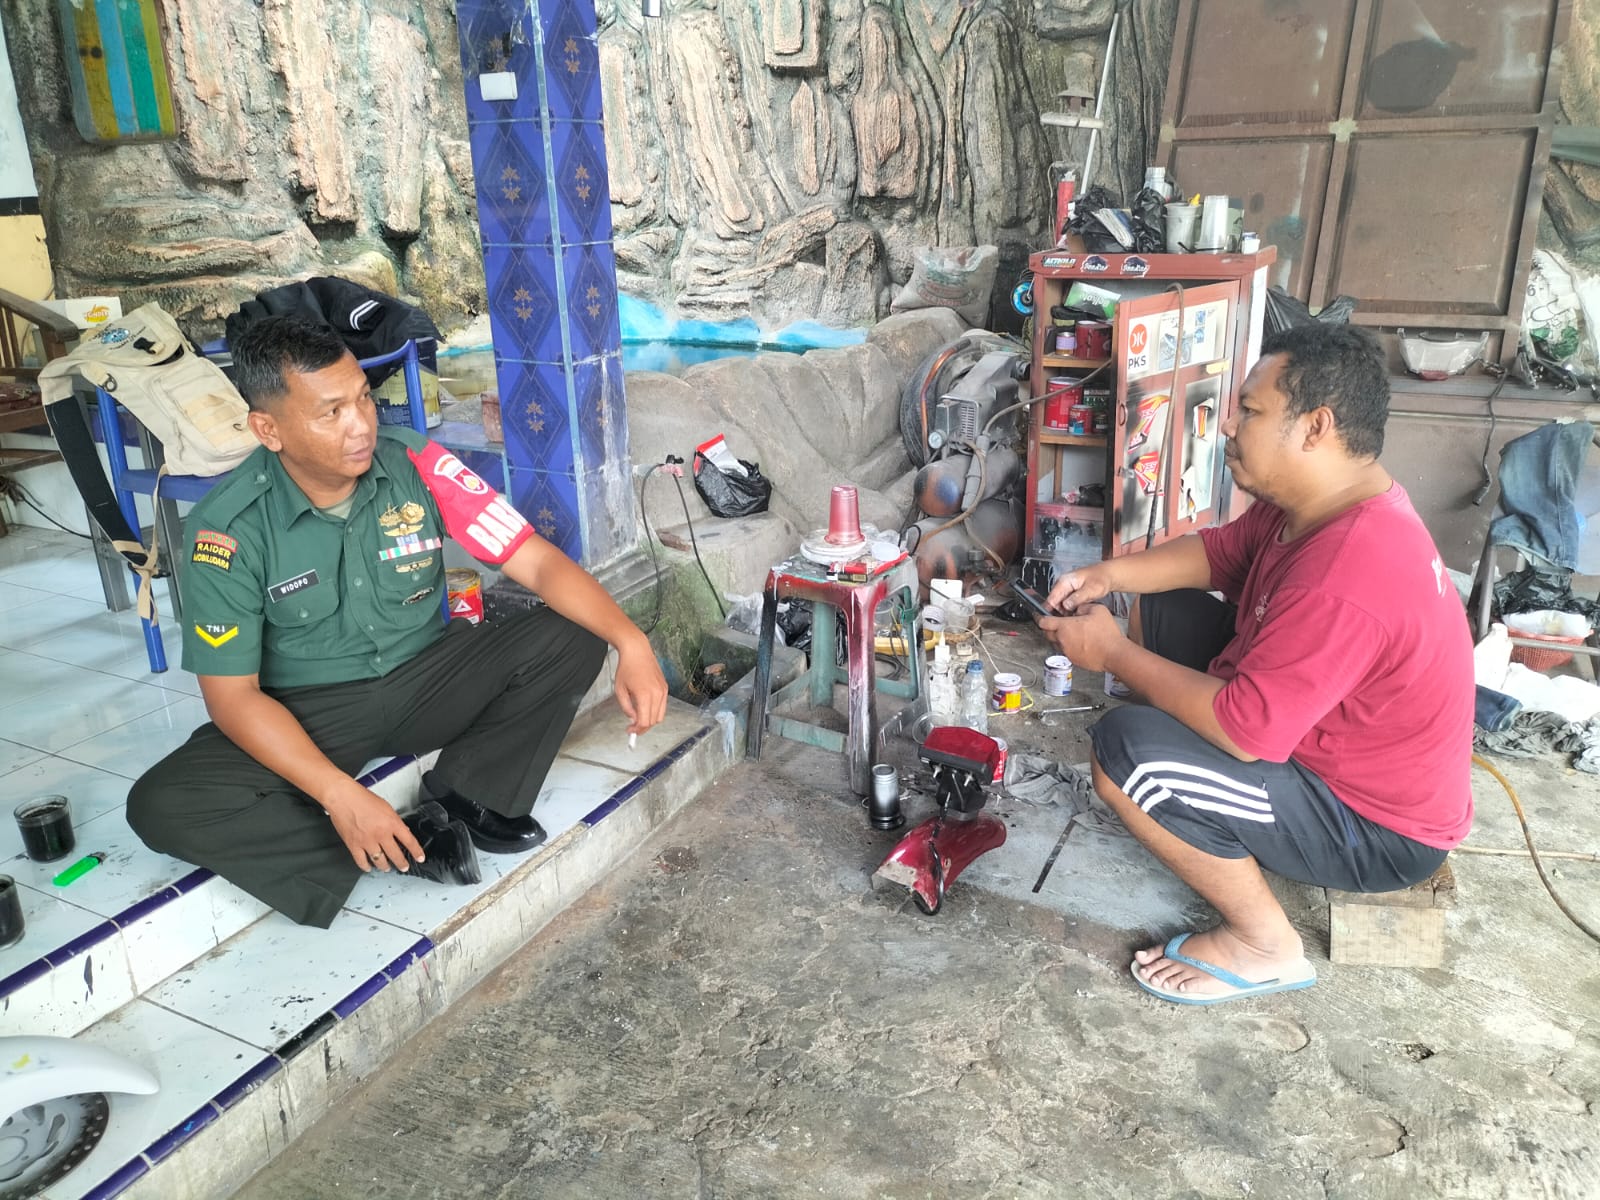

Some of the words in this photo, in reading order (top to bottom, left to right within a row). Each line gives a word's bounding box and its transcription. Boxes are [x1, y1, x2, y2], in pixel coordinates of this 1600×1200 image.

[1127, 355, 1147, 369] PKS
[197, 542, 231, 560] RAIDER
[280, 577, 308, 594] WIDOPO
[206, 624, 226, 633] TNI
